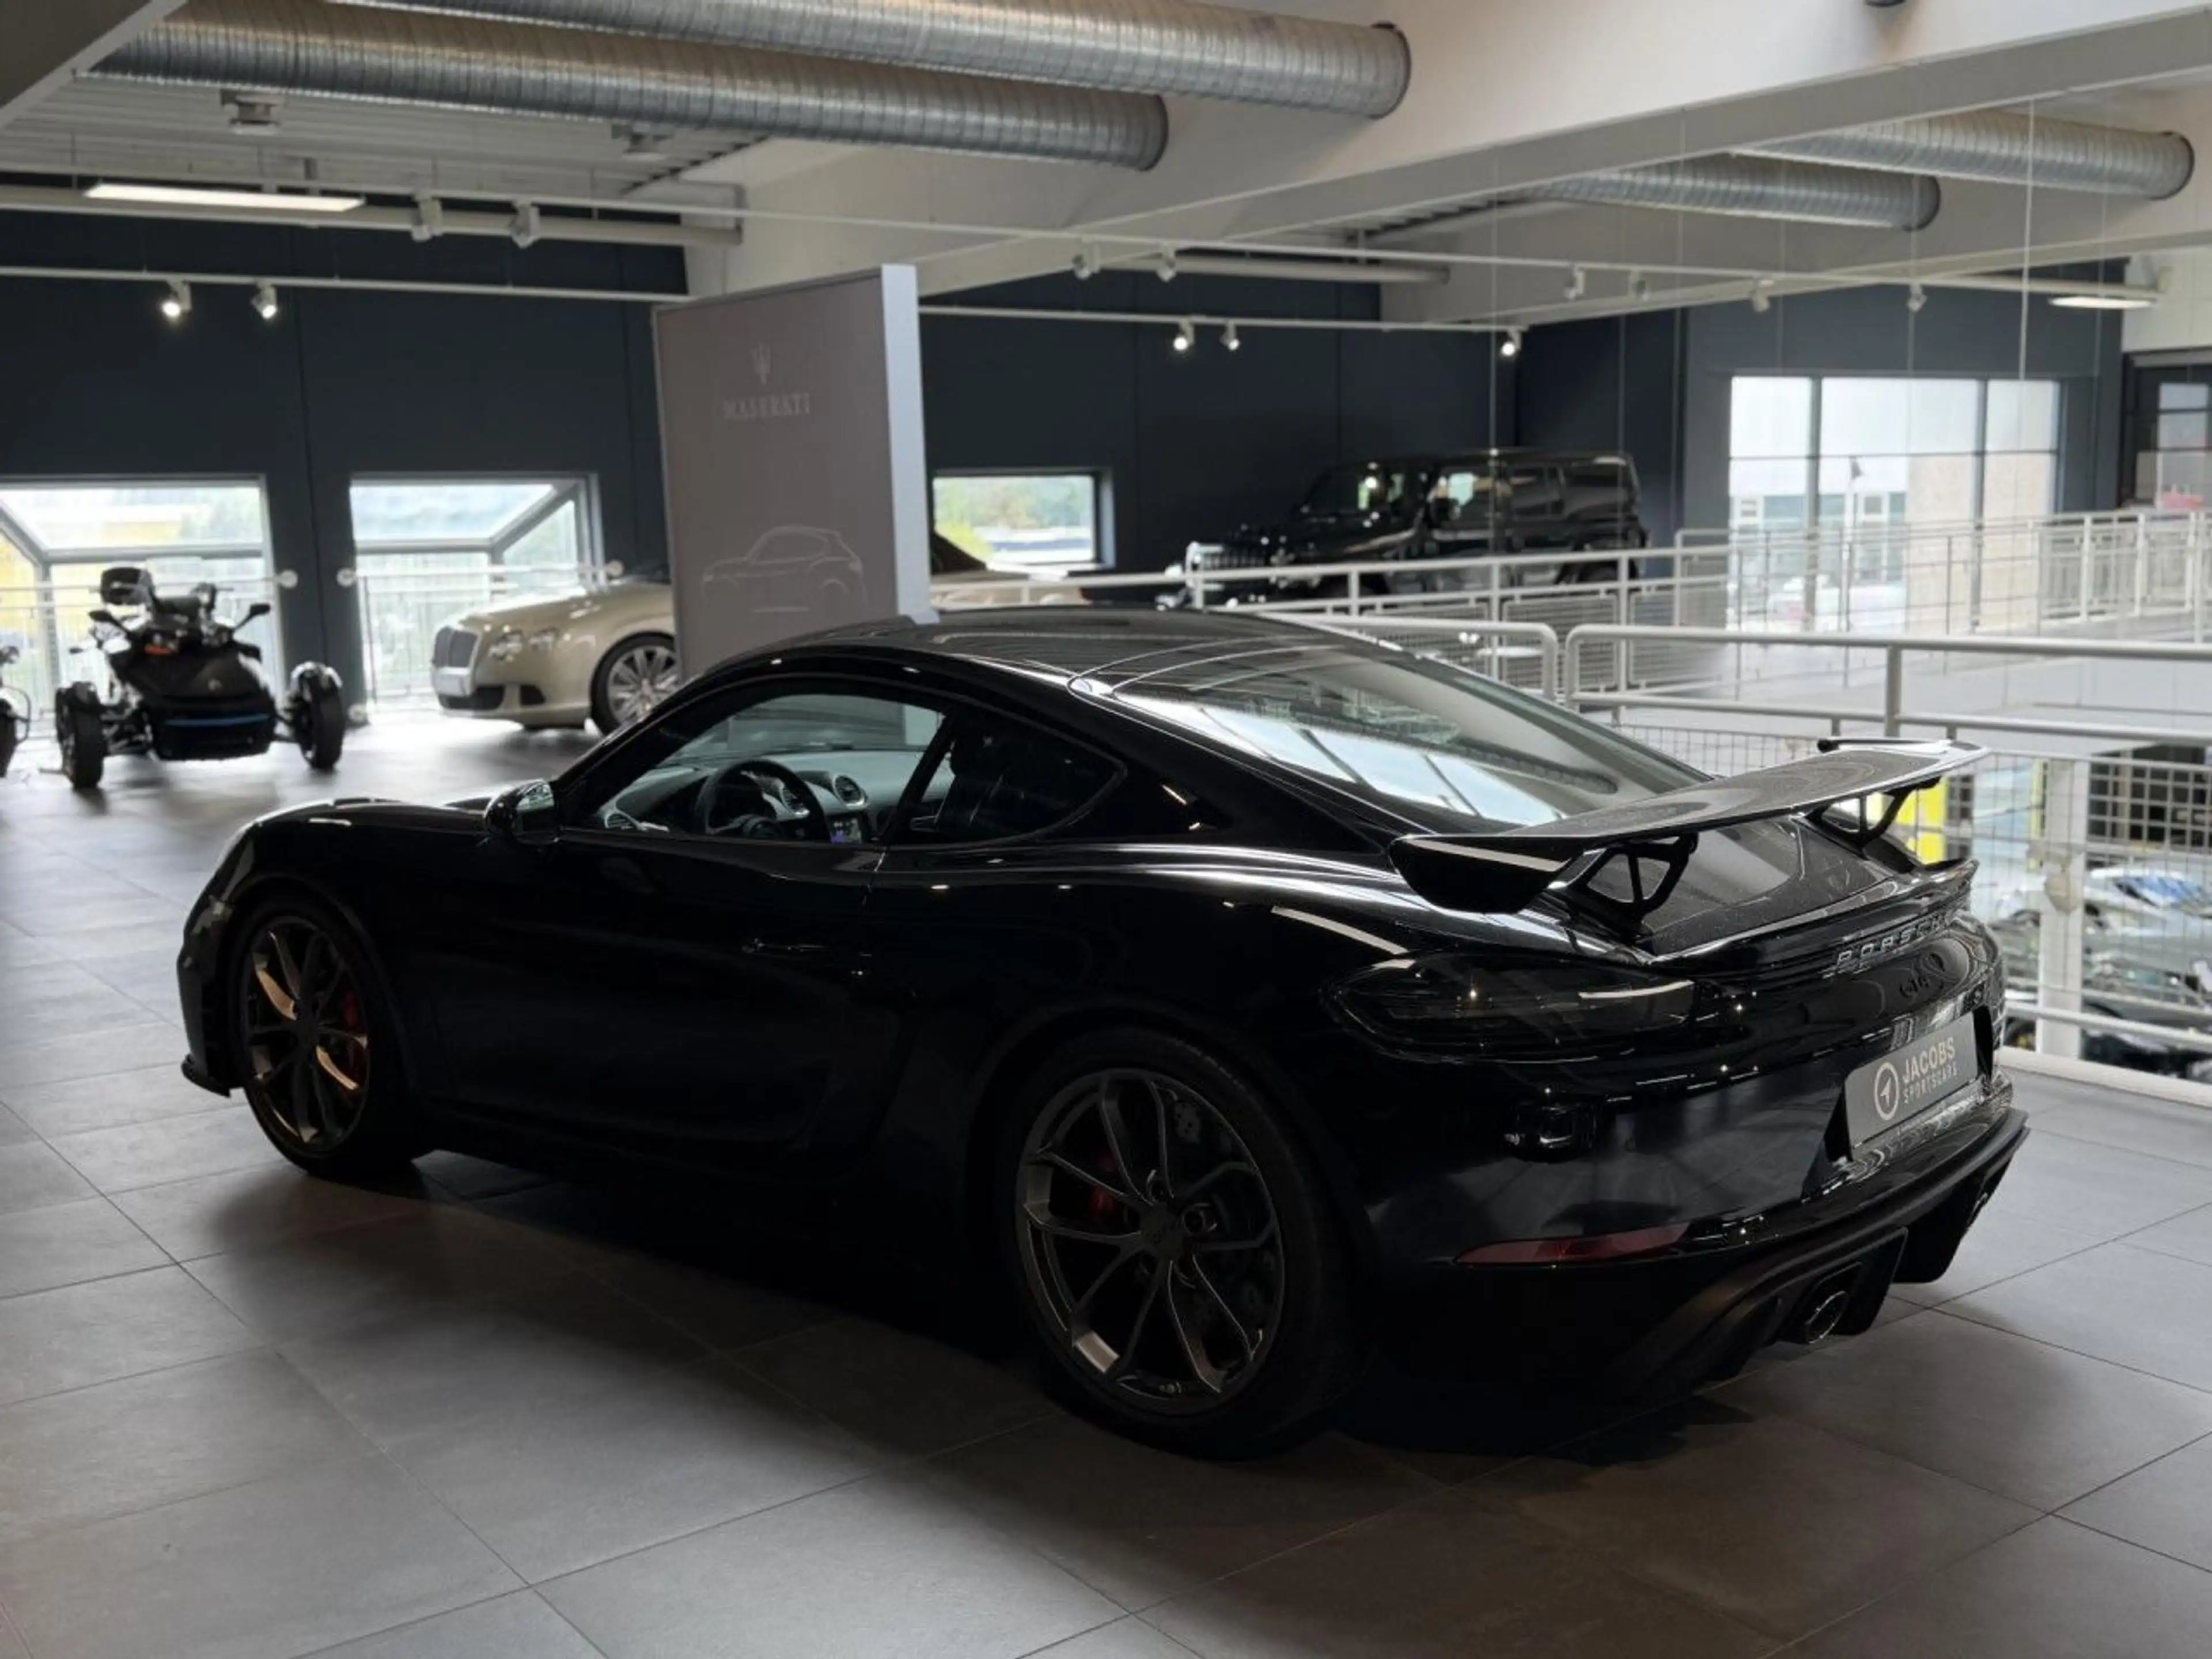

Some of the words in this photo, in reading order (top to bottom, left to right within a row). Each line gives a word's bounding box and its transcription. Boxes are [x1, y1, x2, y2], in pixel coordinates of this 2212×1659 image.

[723, 392, 810, 419] MASERATI
[1837, 911, 1950, 966] PORSCH
[1903, 1037, 1956, 1084] JACOBS
